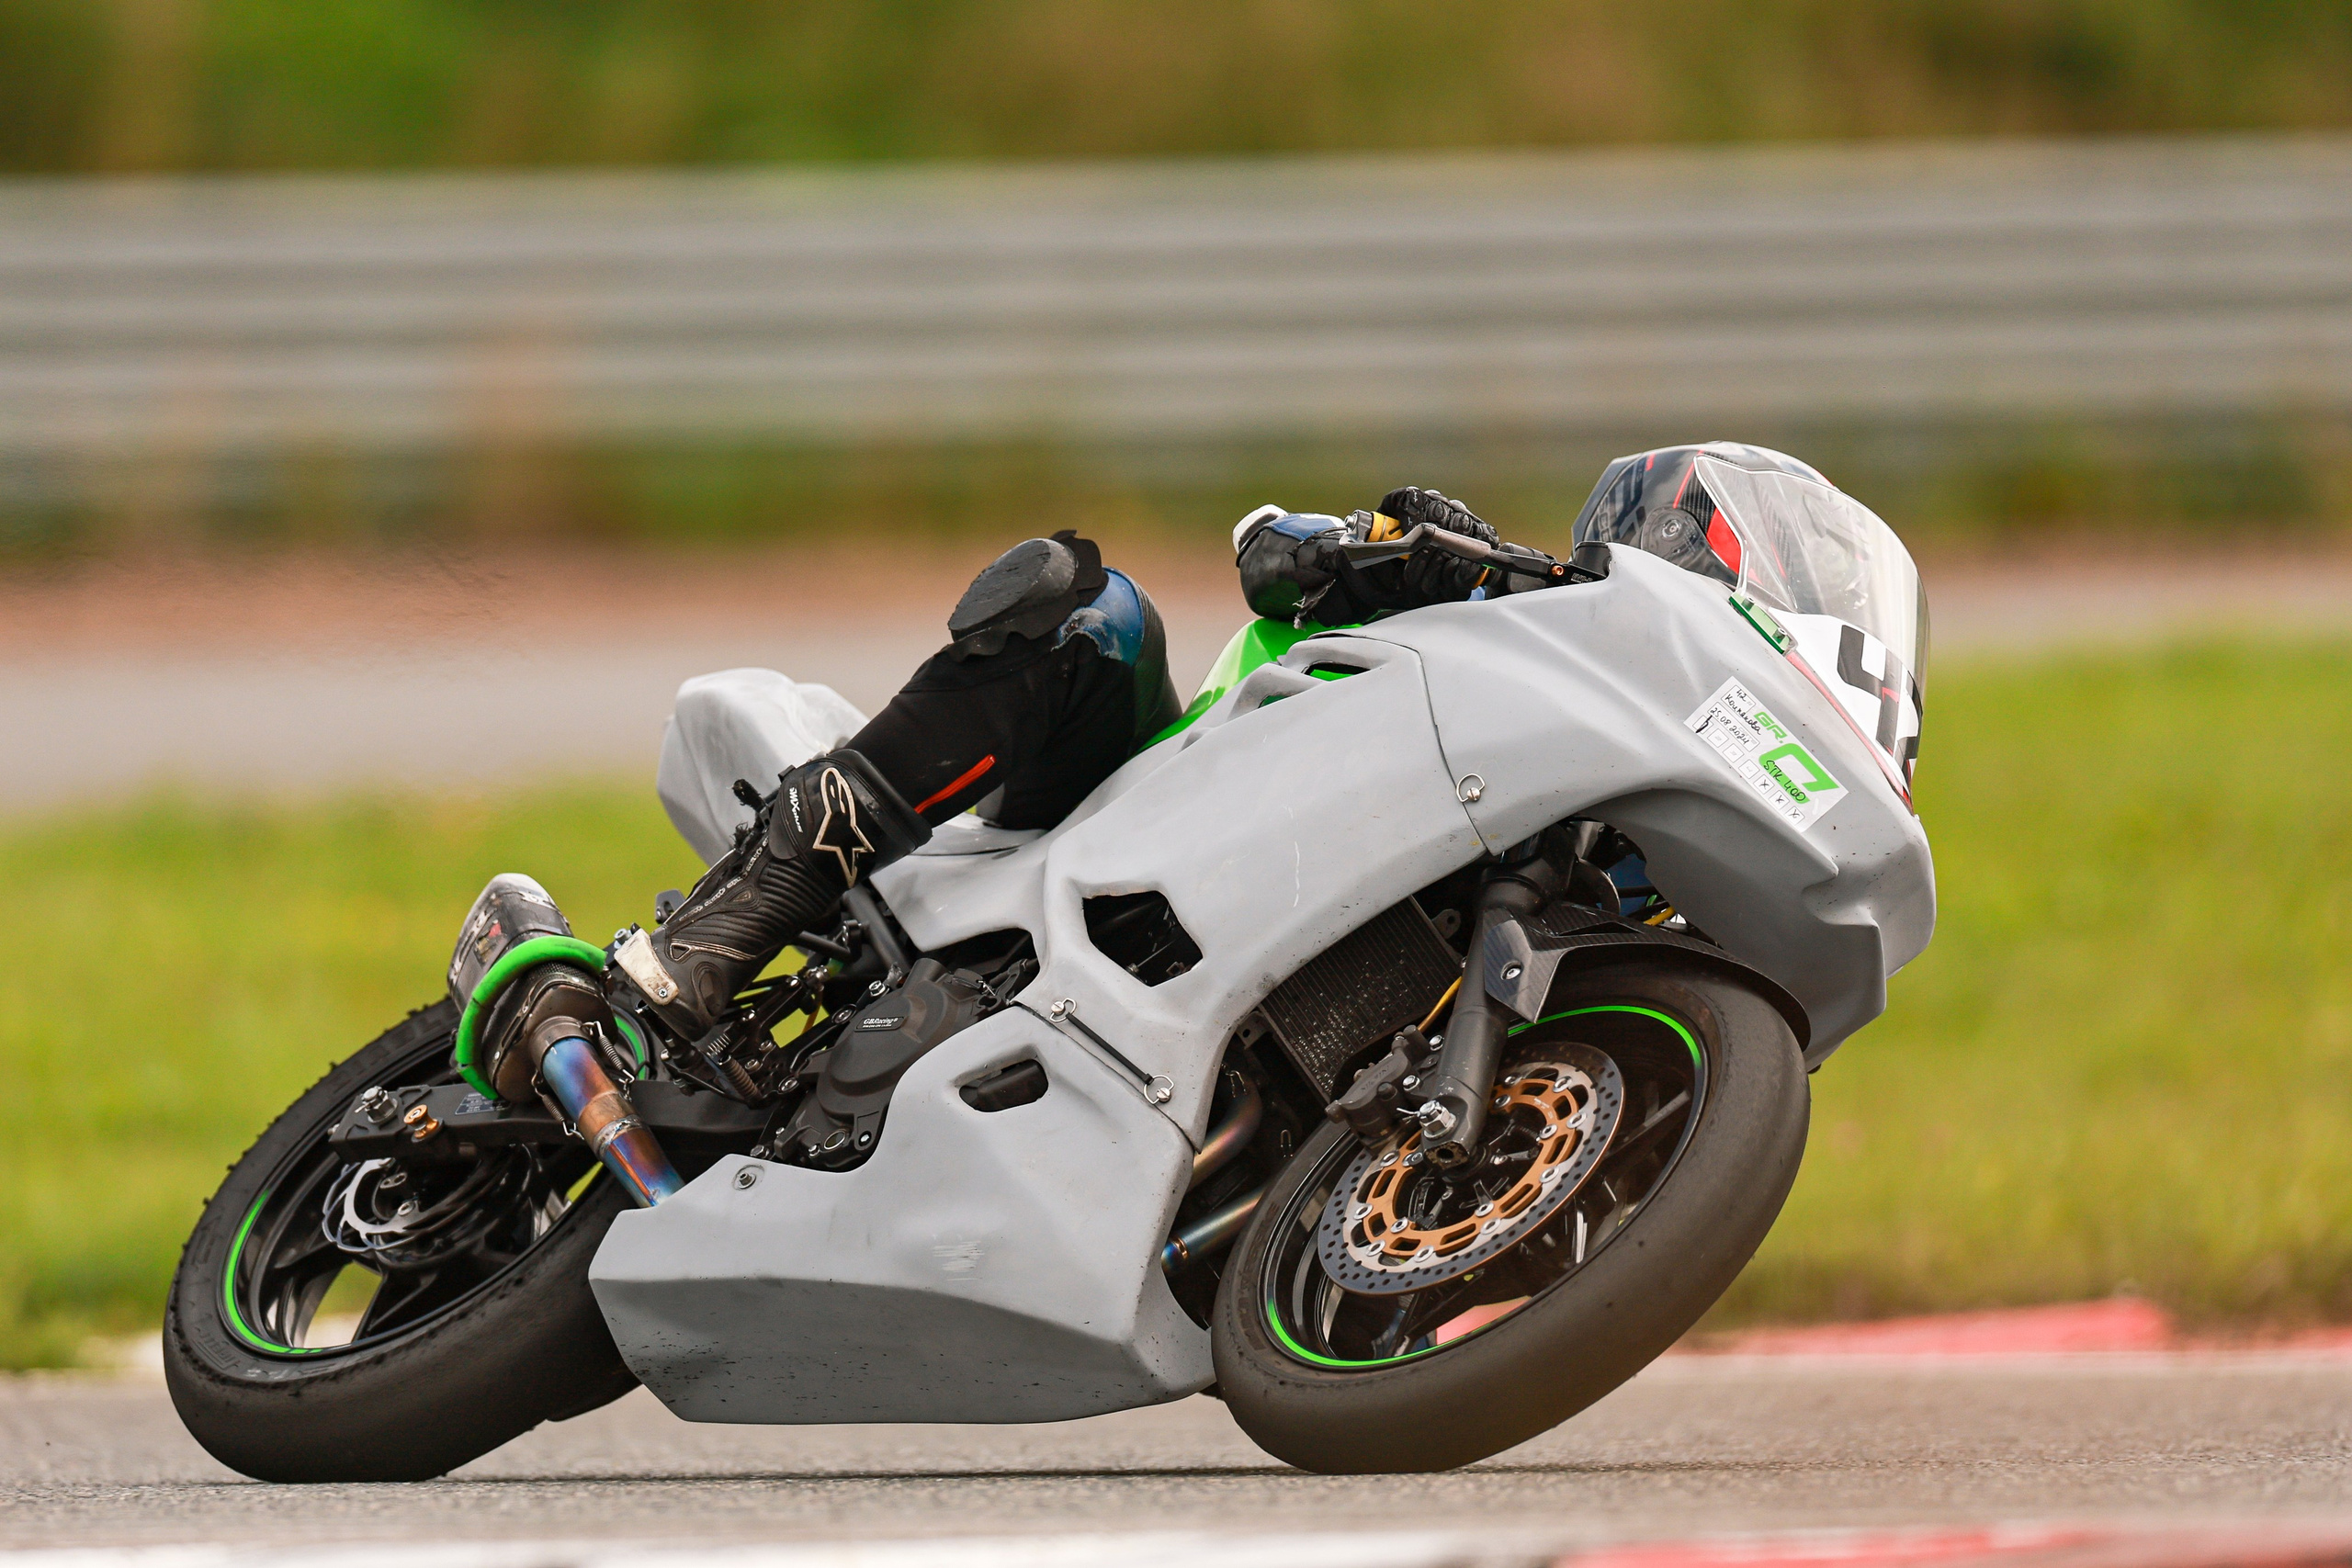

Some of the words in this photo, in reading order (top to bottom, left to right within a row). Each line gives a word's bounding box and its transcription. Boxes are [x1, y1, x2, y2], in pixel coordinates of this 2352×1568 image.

[1736, 688, 1747, 702] 42
[1764, 760, 1783, 782] STK
[1784, 779, 1806, 801] 400
